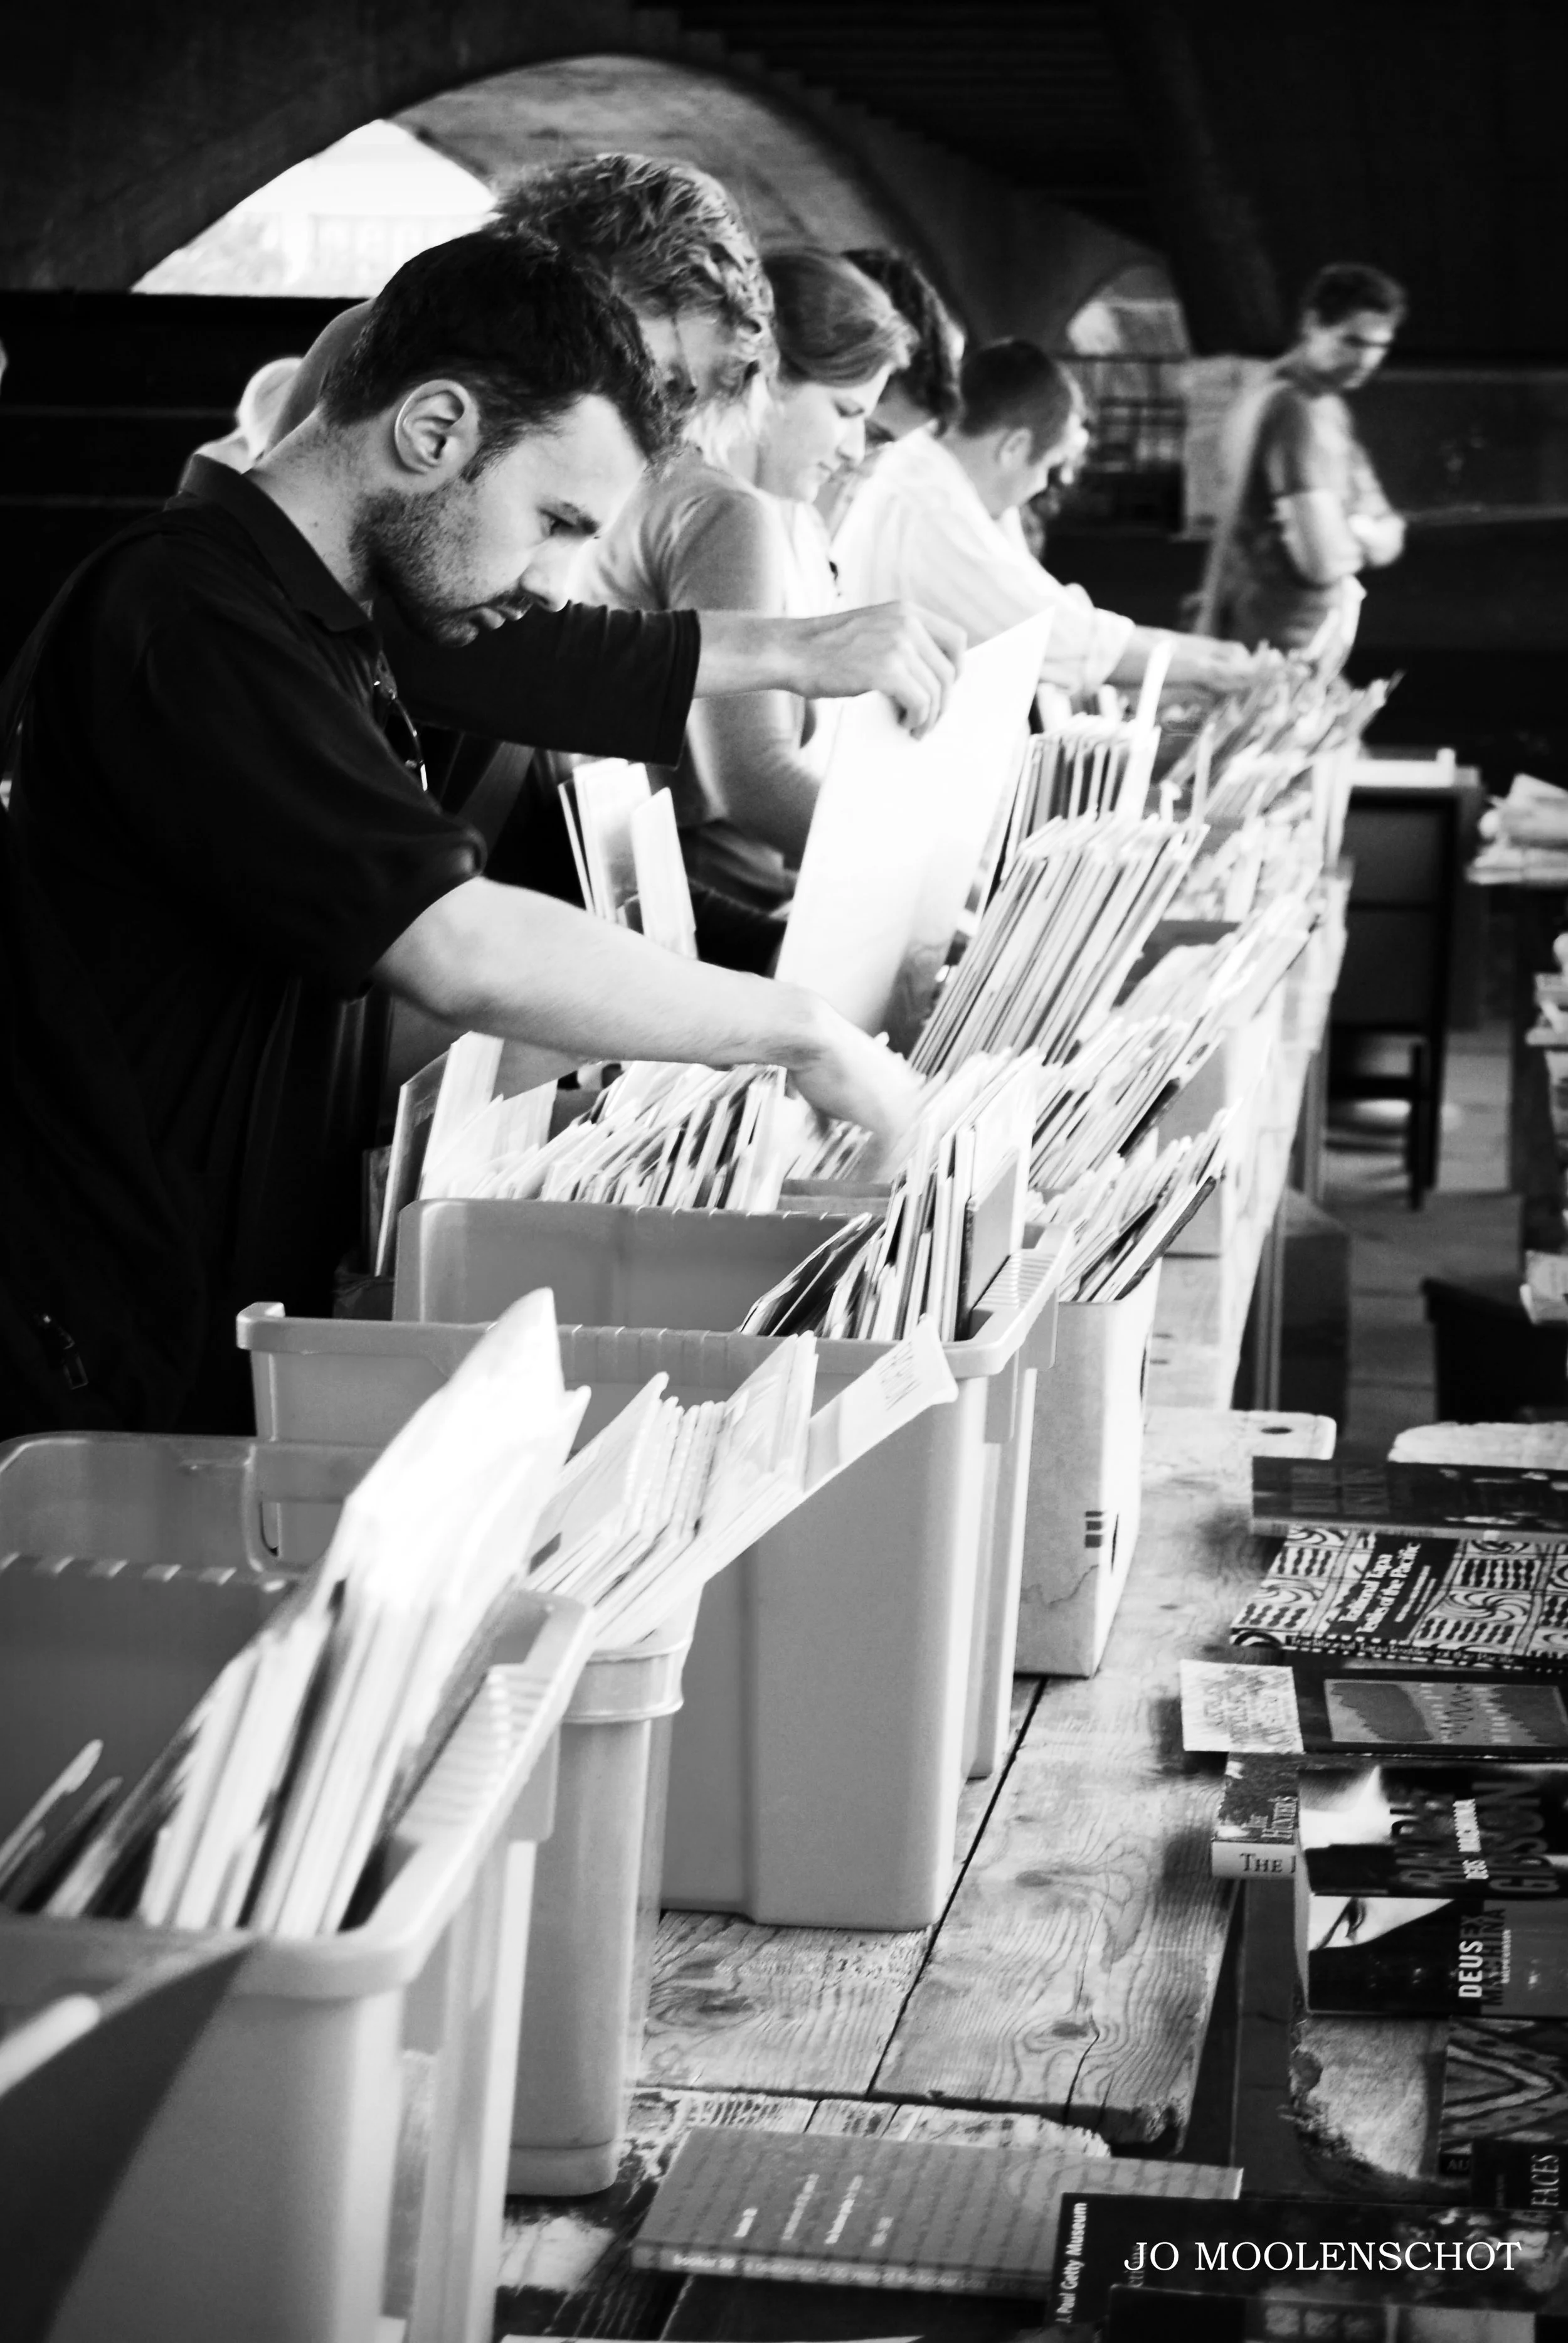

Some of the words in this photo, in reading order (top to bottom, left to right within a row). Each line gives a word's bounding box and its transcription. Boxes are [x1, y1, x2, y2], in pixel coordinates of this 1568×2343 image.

[1389, 1541, 1422, 1578] Pacific
[1239, 1852, 1283, 1873] THE
[1459, 1915, 1483, 1939] EX
[1458, 1940, 1483, 1998] DEUS
[1481, 1909, 1505, 2006] MACHINA
[1530, 2154, 1560, 2207] FACES
[1065, 2202, 1088, 2256] Museum
[1060, 2260, 1085, 2290] Getty
[1056, 2293, 1076, 2314] Paul
